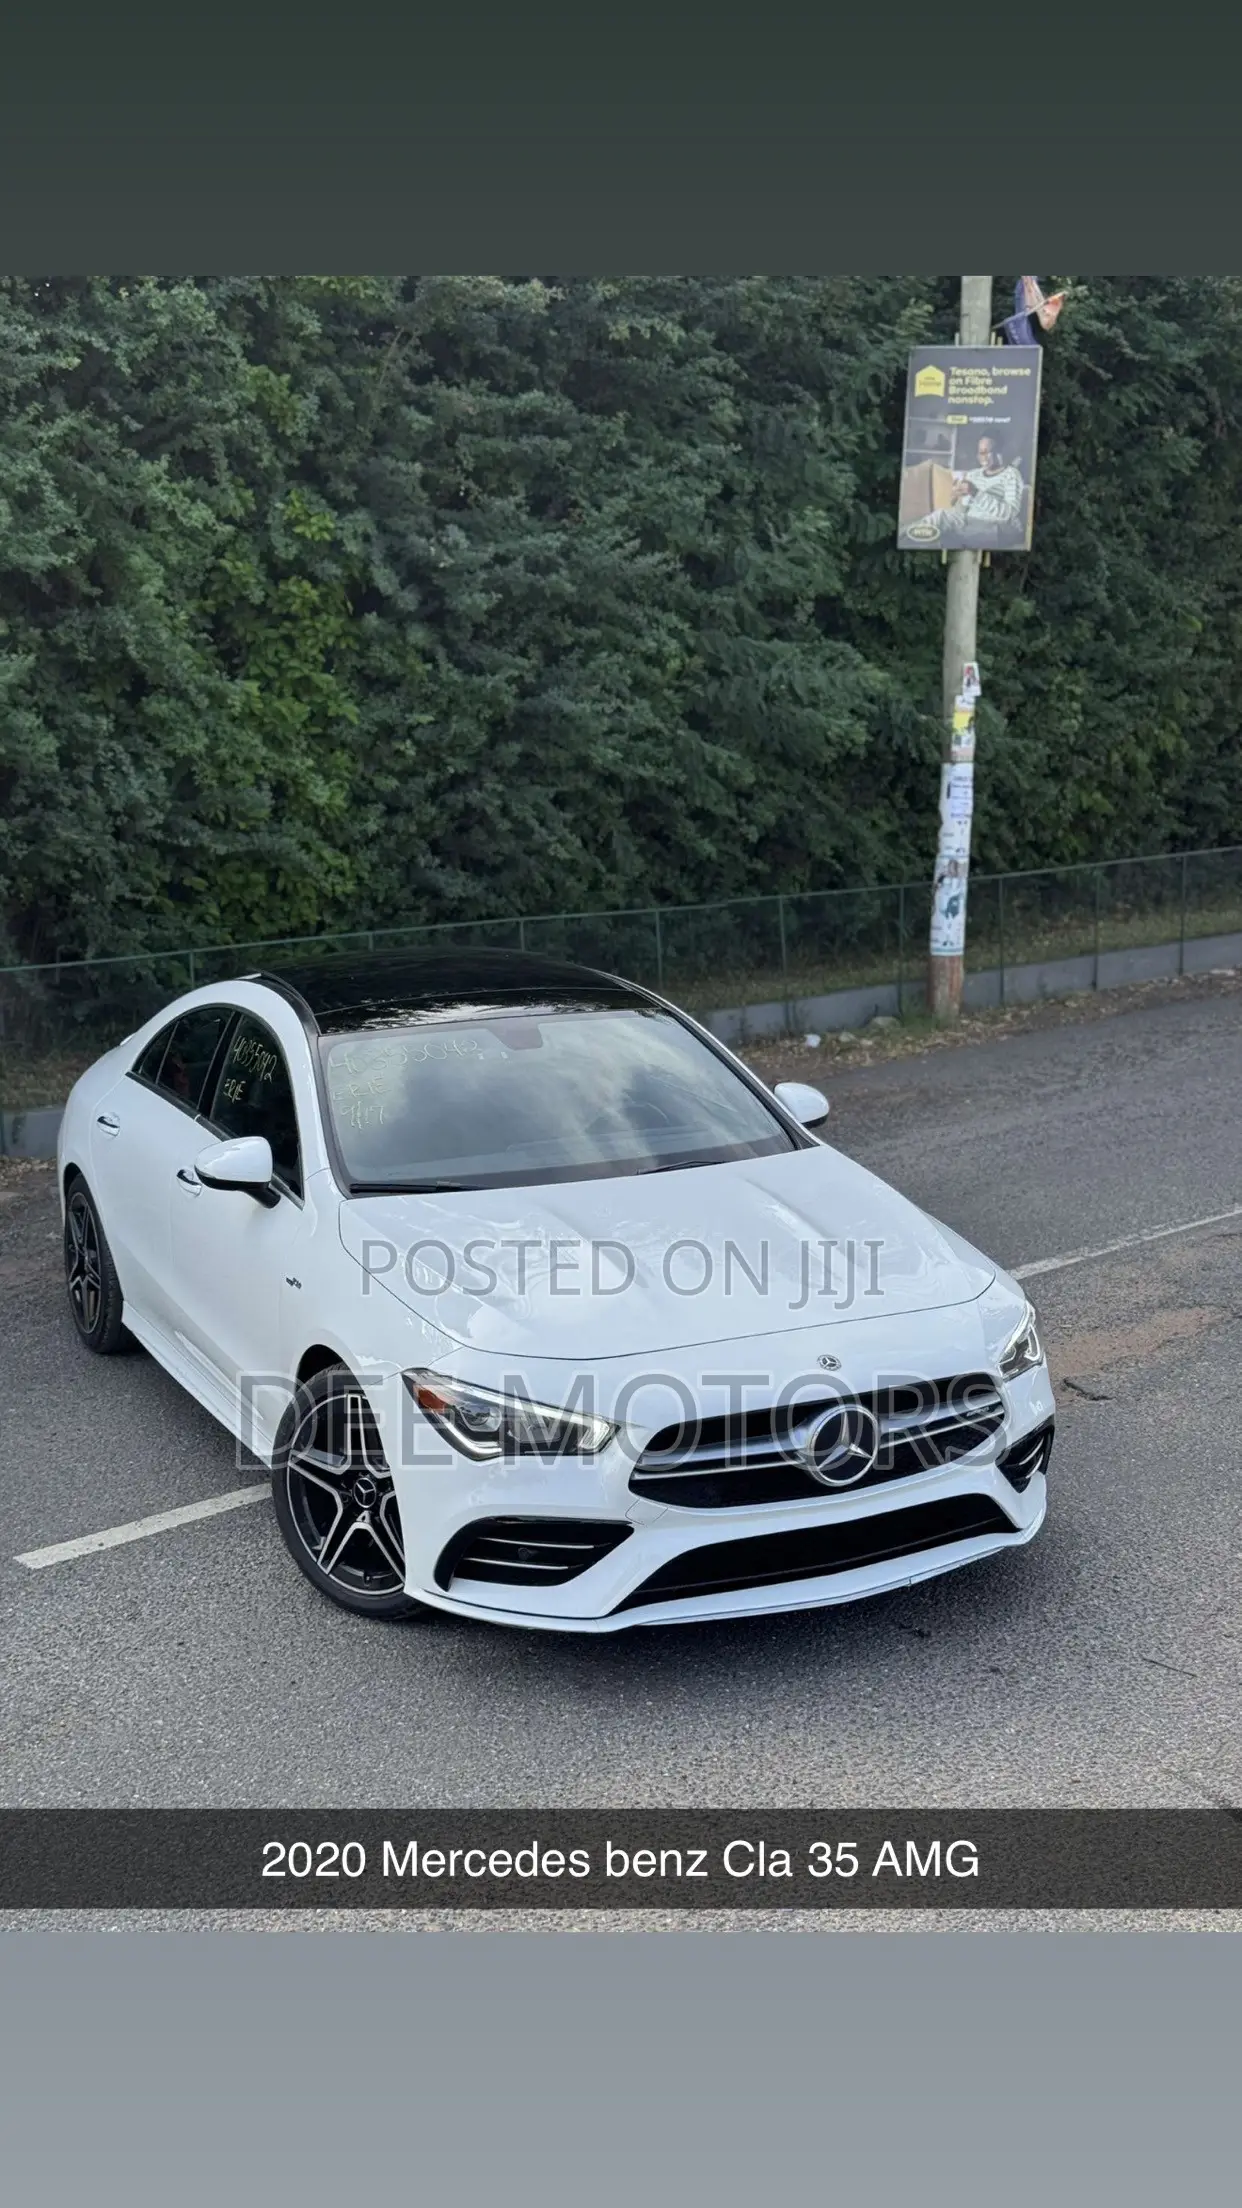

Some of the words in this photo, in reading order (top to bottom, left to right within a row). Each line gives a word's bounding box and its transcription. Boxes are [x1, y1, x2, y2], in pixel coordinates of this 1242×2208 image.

[992, 364, 1031, 376] browse
[948, 377, 963, 385] on
[965, 376, 993, 385] Fibre
[948, 385, 1008, 395] Broadband
[947, 395, 995, 408] nonstop.
